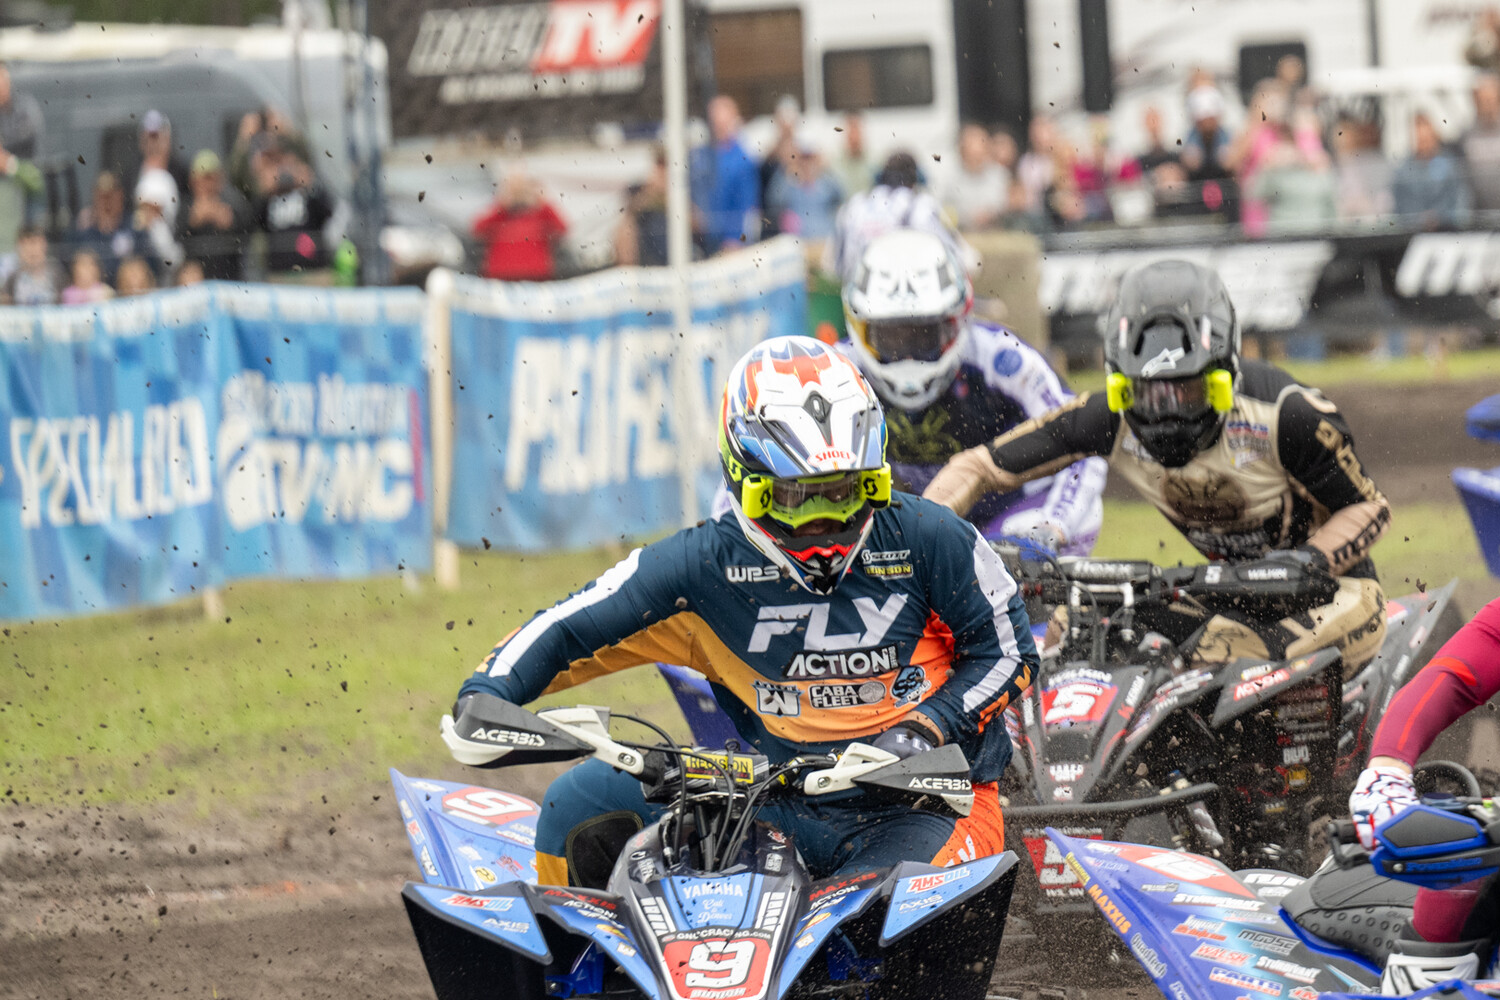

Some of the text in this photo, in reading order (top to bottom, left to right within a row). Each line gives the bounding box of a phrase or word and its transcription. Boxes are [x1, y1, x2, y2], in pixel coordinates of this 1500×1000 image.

[815, 449, 853, 462] SHOEI
[726, 565, 782, 582] WPS
[1205, 566, 1222, 583] 5
[748, 593, 909, 653] FLY
[786, 646, 890, 677] ACTION
[812, 685, 857, 698] CABA
[813, 695, 859, 708] FLEET
[1045, 683, 1104, 723] 5
[471, 727, 545, 747] ACERBIS
[908, 777, 973, 791] ACERBIS
[683, 881, 743, 898] YAMAHA
[809, 872, 877, 901] MAXXIS
[907, 866, 971, 893] AMSOIL
[442, 895, 515, 911] AMSOIL
[543, 889, 617, 910] MAXXIS
[810, 886, 857, 910] ACTION
[563, 900, 615, 918] ACTION
[1087, 884, 1132, 935] MAXXIS
[1238, 929, 1299, 950] MOOSE
[685, 940, 756, 988] 9
[1213, 968, 1282, 991] PARTS
